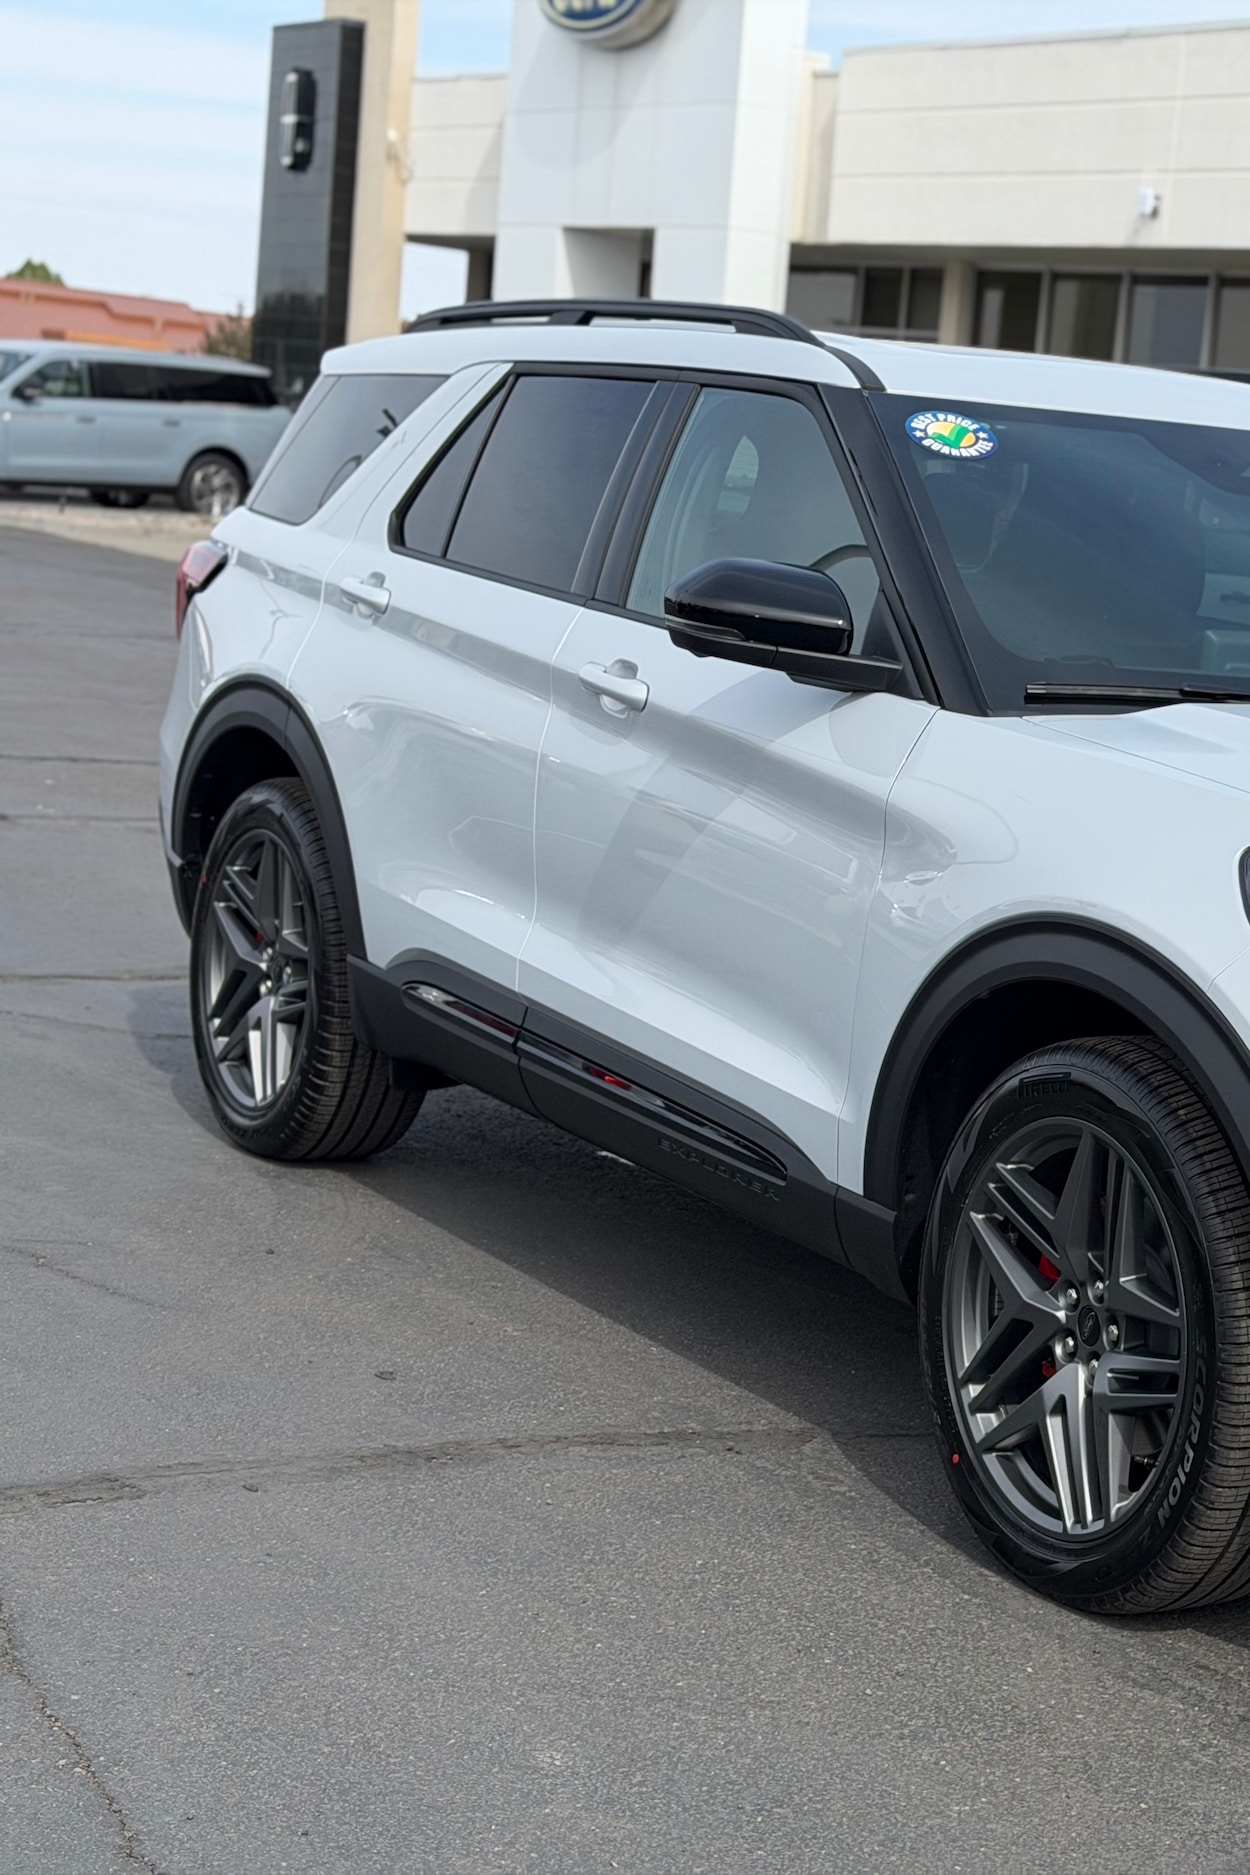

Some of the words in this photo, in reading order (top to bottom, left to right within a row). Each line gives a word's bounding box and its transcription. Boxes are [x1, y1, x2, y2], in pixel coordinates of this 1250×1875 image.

[910, 413, 936, 430] BEST
[936, 413, 980, 431] PRICE
[921, 438, 993, 457] GUARANTEE
[657, 1136, 780, 1201] EXPLORER
[1157, 1327, 1207, 1529] SCORPION
